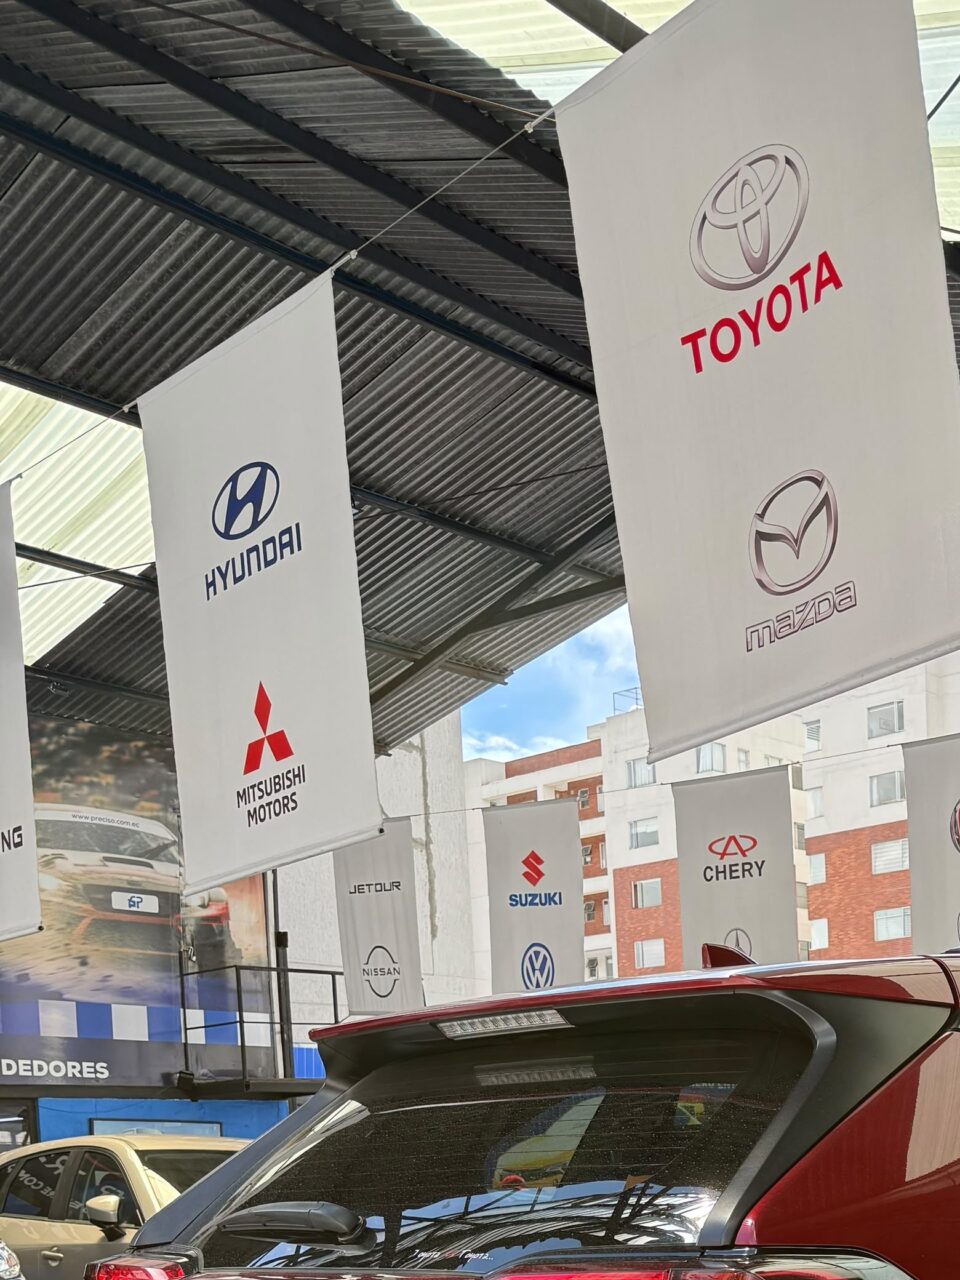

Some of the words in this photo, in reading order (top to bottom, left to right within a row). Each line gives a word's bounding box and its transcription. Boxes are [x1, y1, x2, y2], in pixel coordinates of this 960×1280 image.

[680, 250, 843, 374] TOYOTA
[205, 522, 302, 601] HYUNDAI
[236, 764, 306, 808] MITSUBISHI
[247, 791, 298, 828] MOTORS
[703, 860, 766, 882] CHERY
[349, 881, 401, 894] JETOUR
[508, 892, 563, 907] SUZUKI
[362, 967, 401, 976] NISSAN
[1, 1059, 110, 1079] DEDORES
